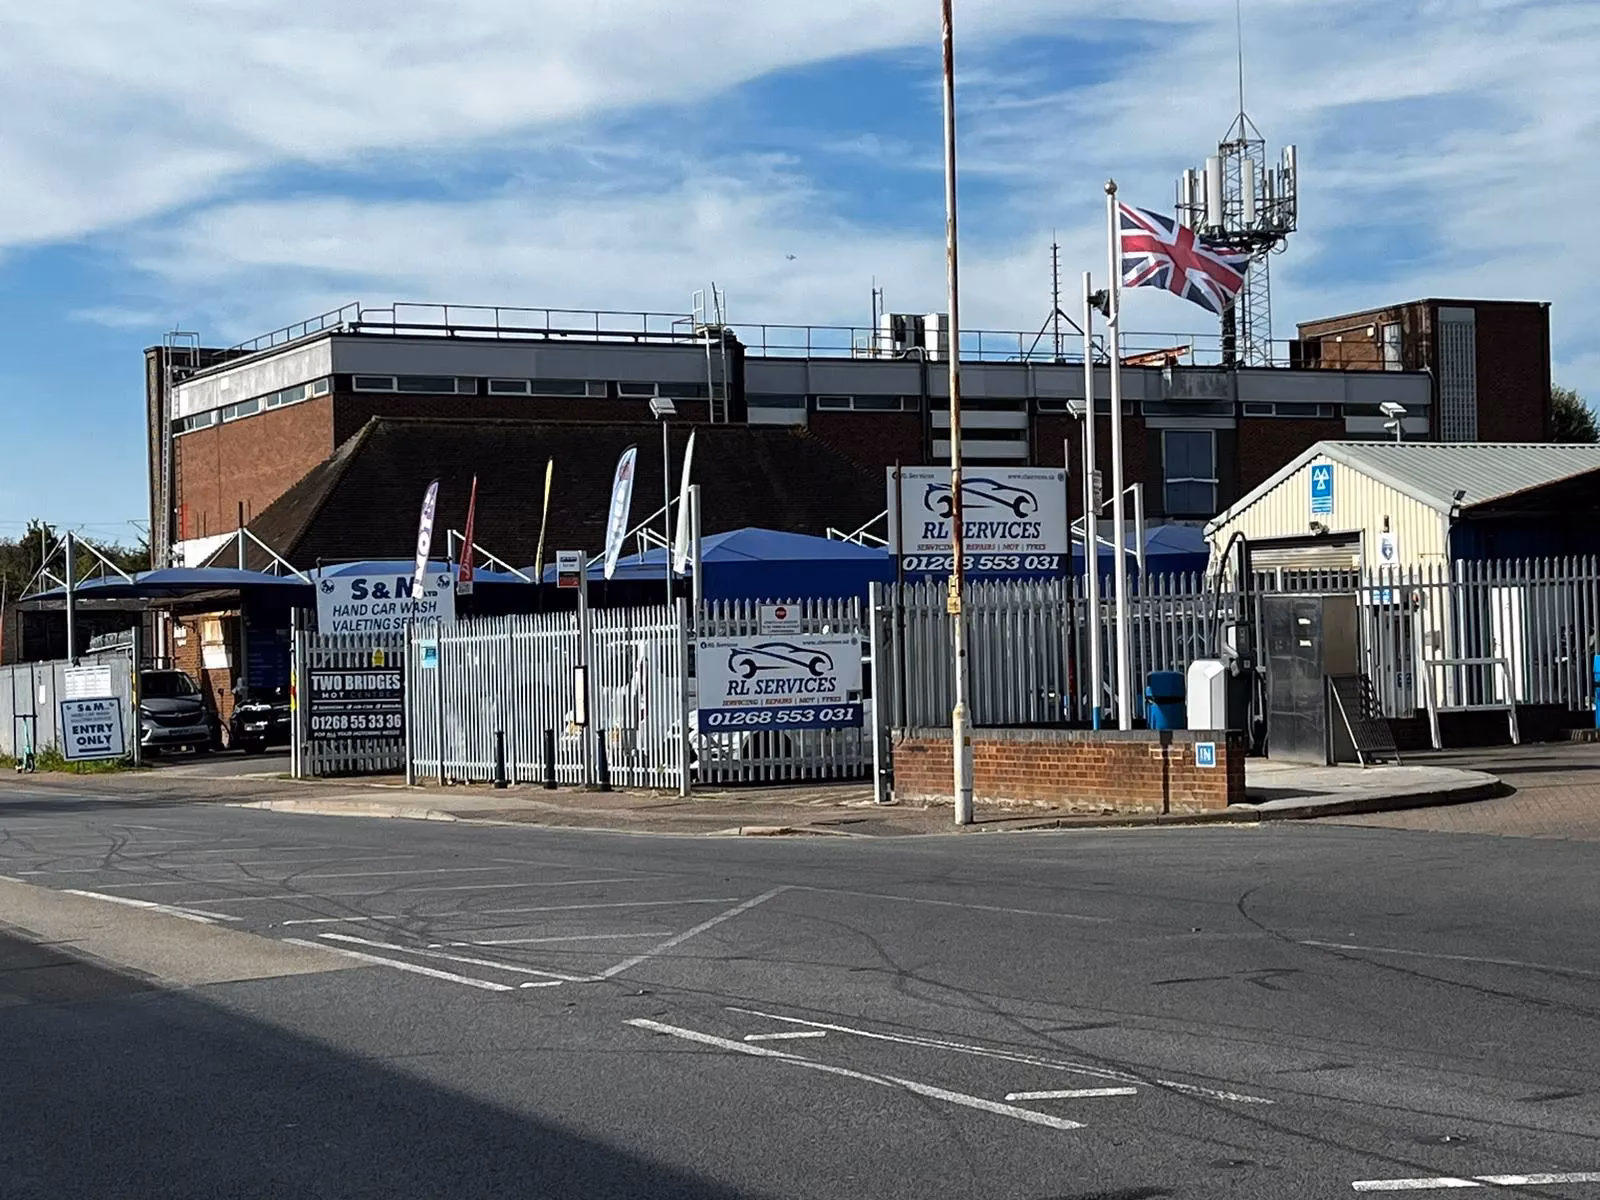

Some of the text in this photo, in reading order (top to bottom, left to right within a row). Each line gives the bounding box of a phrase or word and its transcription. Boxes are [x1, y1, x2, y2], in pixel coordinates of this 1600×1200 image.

[922, 521, 1041, 539] RL ERVICES
[977, 556, 1020, 570] 553
[1024, 555, 1060, 570] 031
[332, 601, 437, 617] HAND CAR WASH
[332, 618, 391, 632] VALETING
[311, 674, 401, 691] TWO BRIDGES
[726, 677, 837, 696] RL SERVICES
[311, 714, 402, 730] 01268 55 33 36
[708, 708, 854, 726] 01268 553 031
[72, 723, 114, 735] ENTRY
[76, 734, 112, 746] ONLY
[1200, 747, 1211, 761] IN
